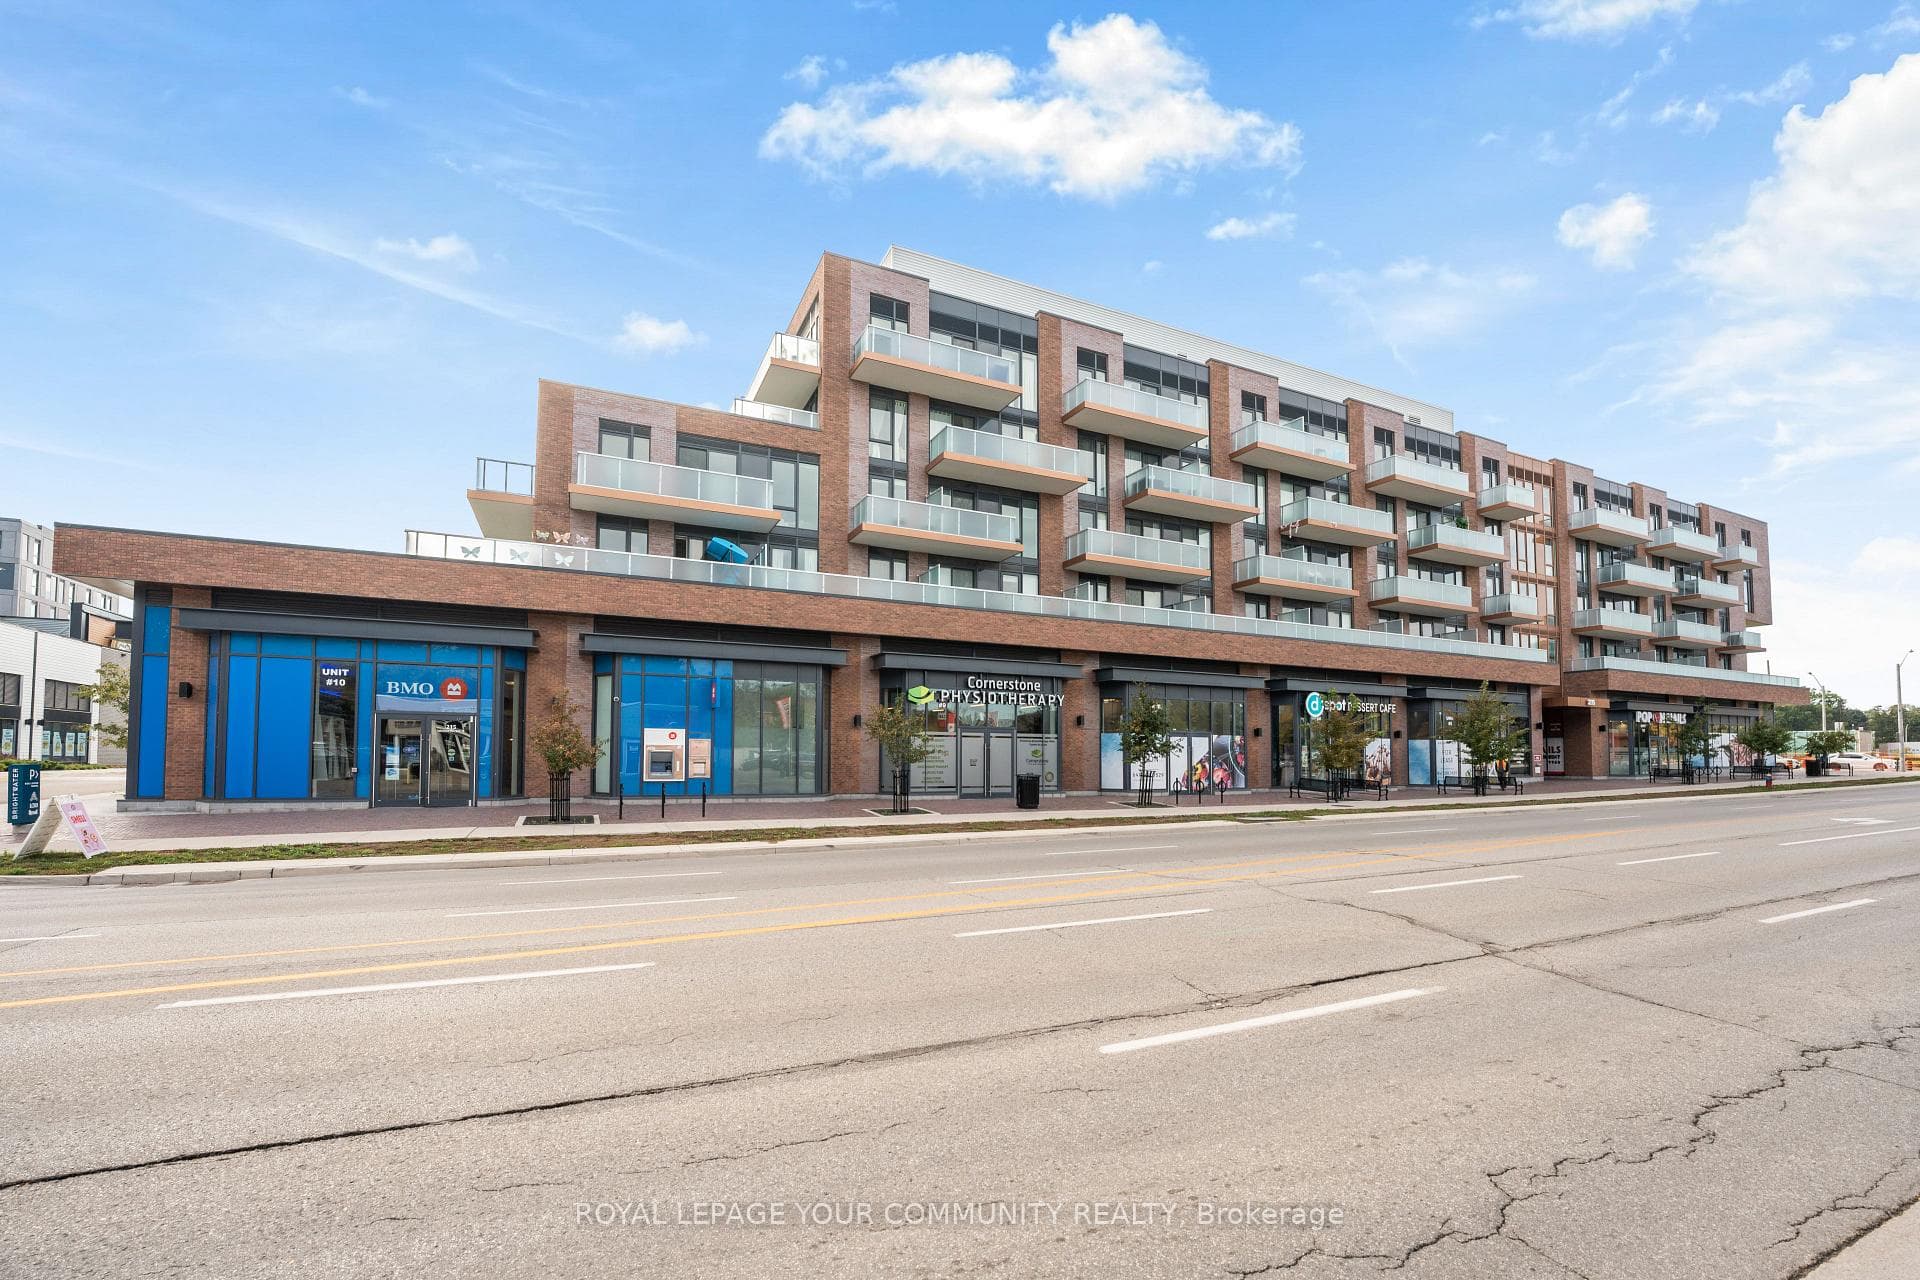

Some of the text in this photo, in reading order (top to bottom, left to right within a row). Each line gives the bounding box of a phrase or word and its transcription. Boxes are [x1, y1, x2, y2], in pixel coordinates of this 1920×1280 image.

[322, 668, 350, 677] UNIT
[325, 678, 346, 686] #10
[386, 681, 434, 695] BMO
[967, 676, 1041, 692] Cornerstone
[941, 690, 1065, 707] PHYSIOTHERAPY
[1348, 702, 1378, 713] DSSERT
[1380, 703, 1397, 714] CAFE
[1635, 711, 1653, 723] POP
